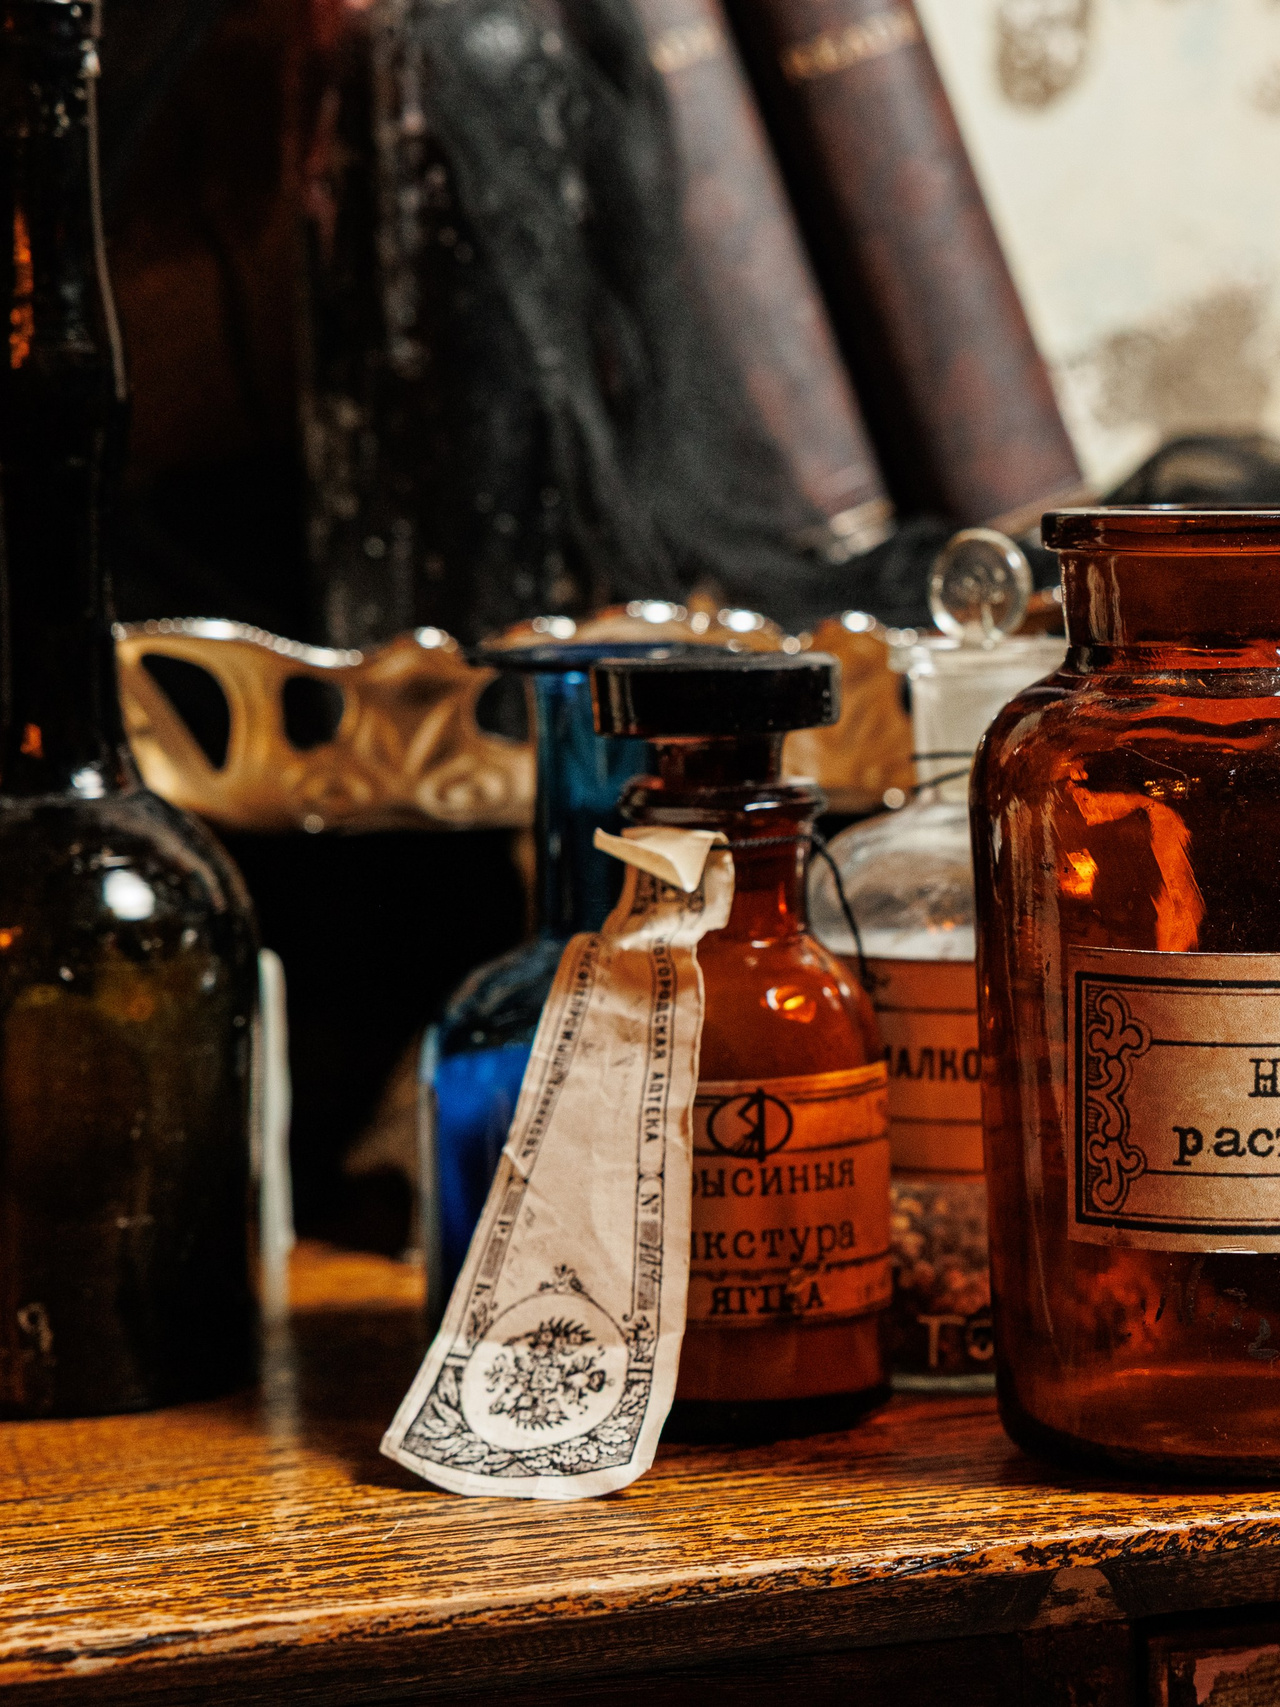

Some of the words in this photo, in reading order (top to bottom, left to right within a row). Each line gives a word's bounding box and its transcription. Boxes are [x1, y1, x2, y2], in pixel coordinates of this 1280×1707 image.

[884, 1045, 982, 1082] АЛКО
[645, 1072, 666, 1144] АПТЕКА
[692, 1157, 855, 1198] ысиныя
